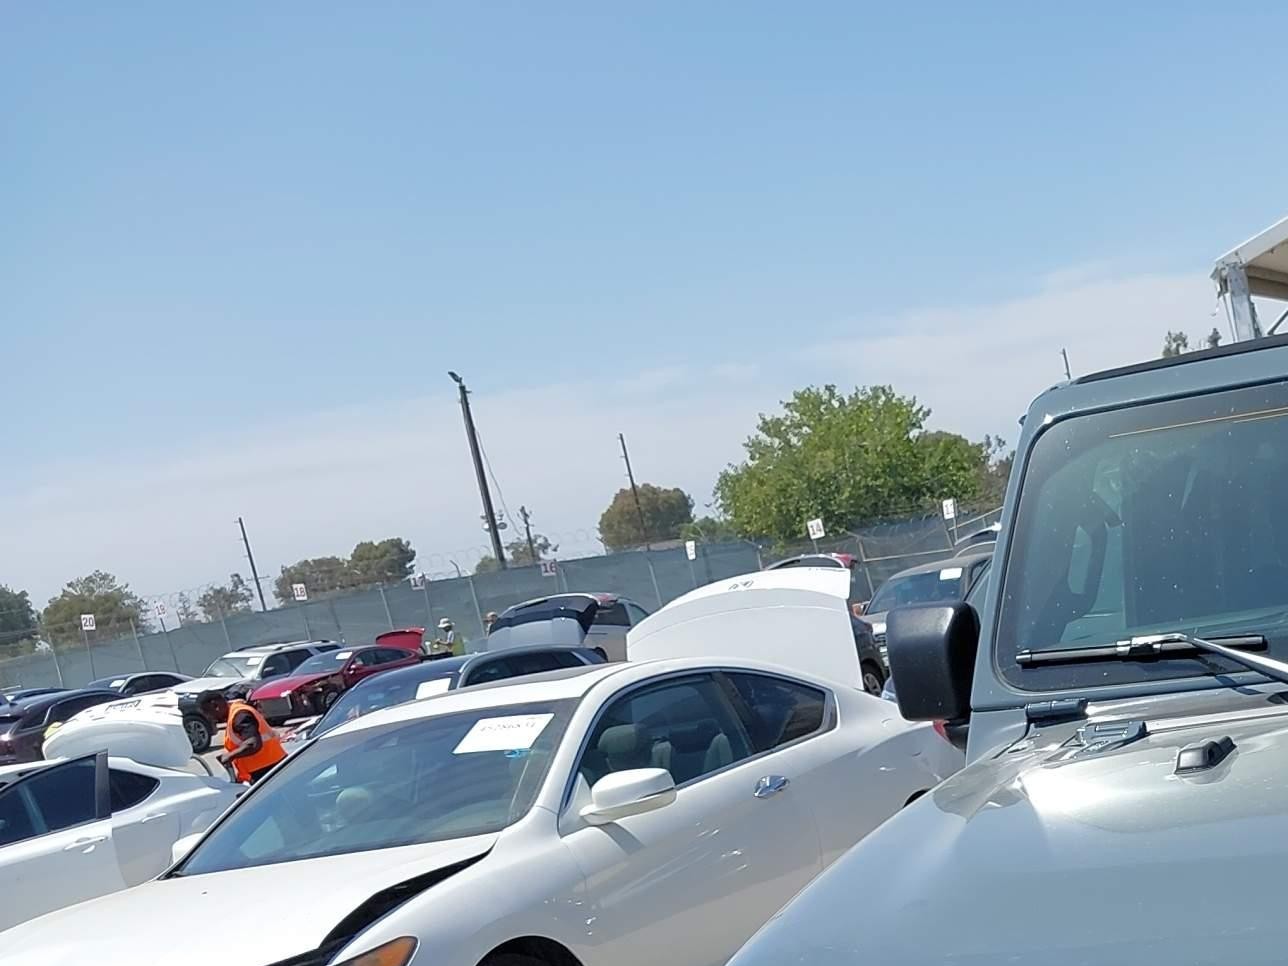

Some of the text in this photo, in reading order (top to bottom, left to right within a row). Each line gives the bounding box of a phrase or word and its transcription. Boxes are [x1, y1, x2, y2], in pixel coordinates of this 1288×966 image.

[543, 561, 557, 573] 16
[294, 586, 306, 598] 18
[82, 616, 95, 628] 20
